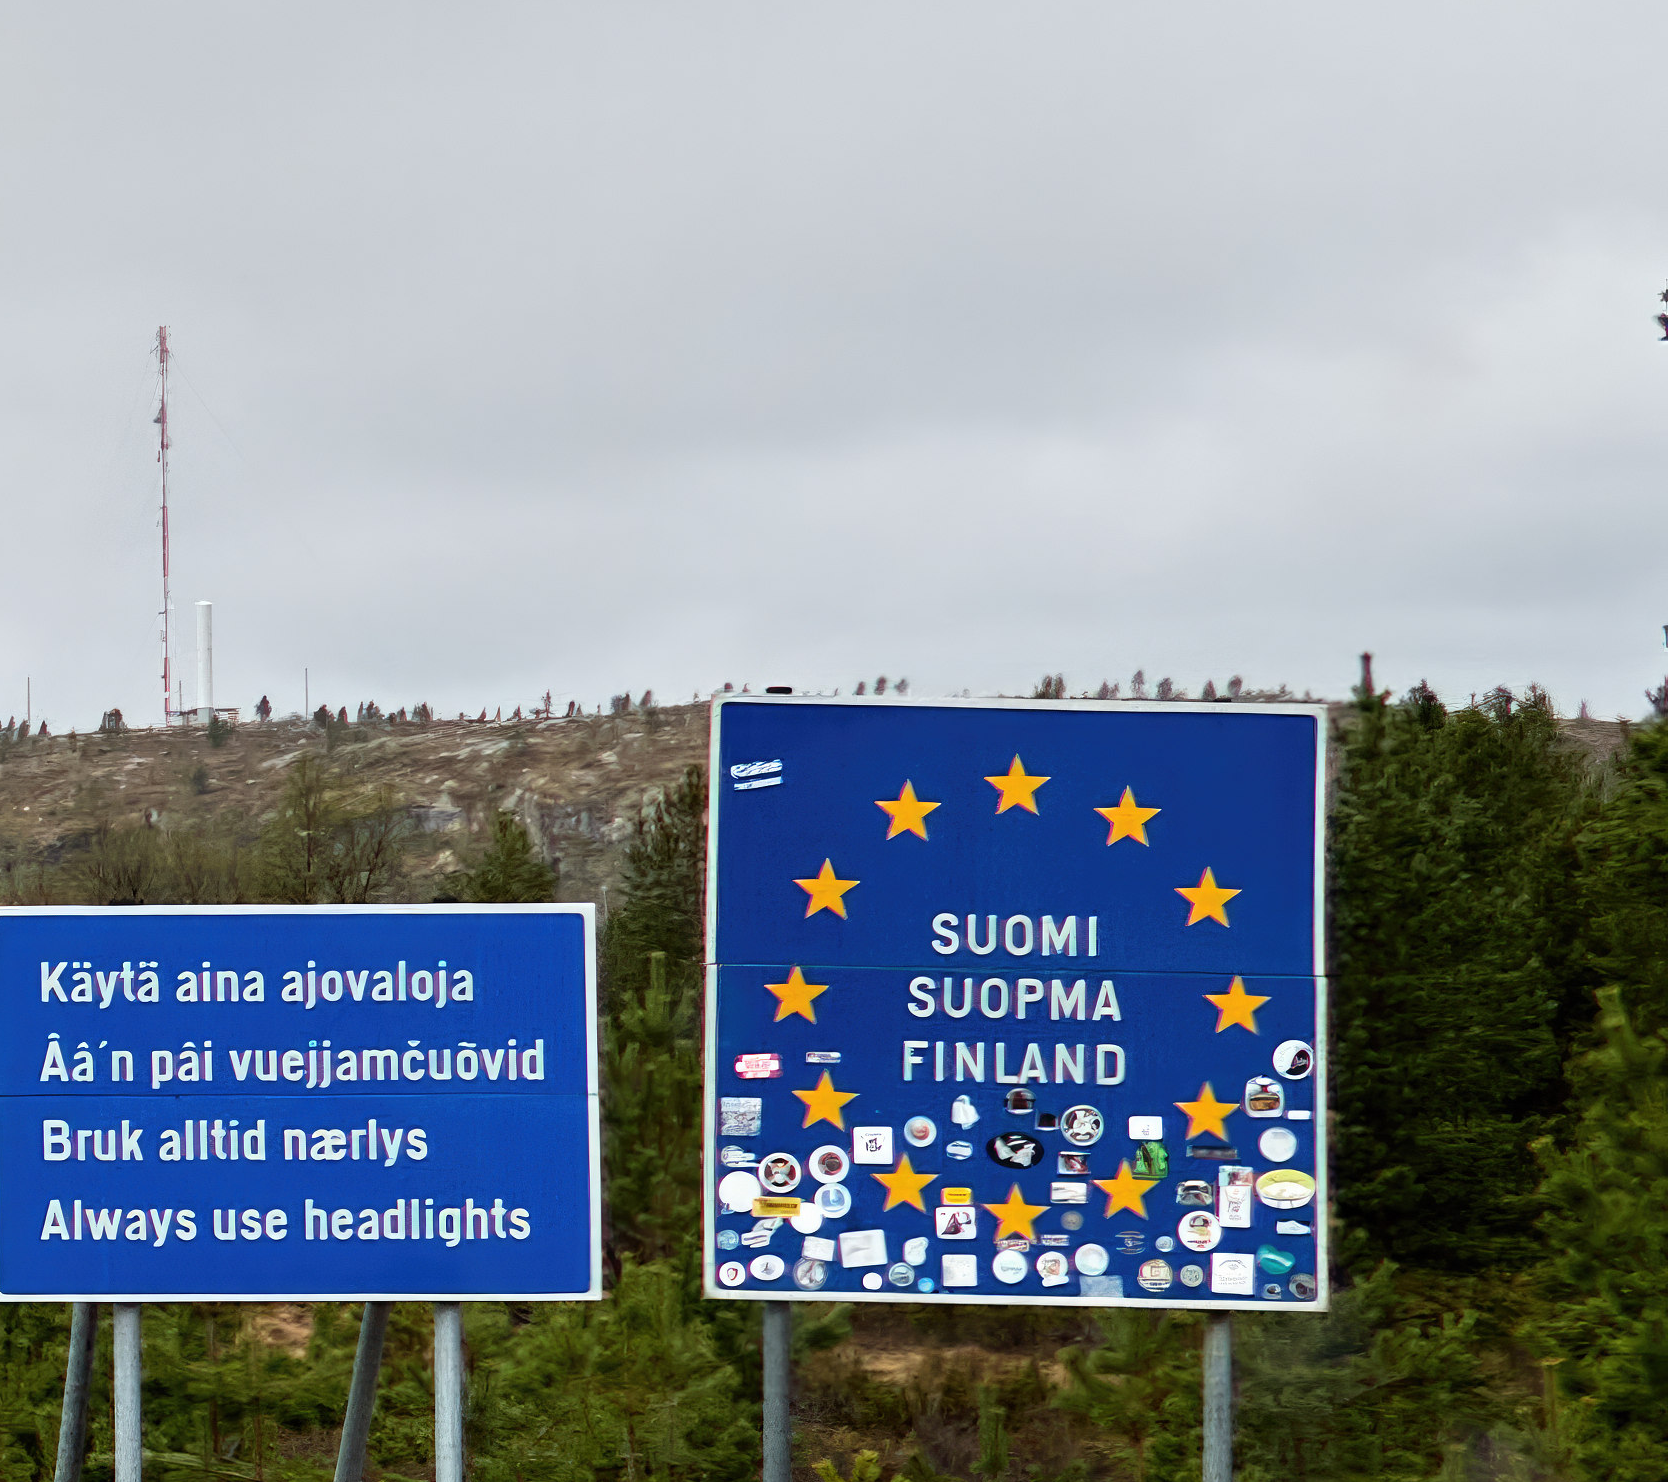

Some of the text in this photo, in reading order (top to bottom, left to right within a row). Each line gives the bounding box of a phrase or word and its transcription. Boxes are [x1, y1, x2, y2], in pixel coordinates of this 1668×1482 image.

[932, 913, 1097, 956] SUOMI
[41, 961, 474, 1009] Käytä aina ajovaloja
[908, 977, 1122, 1021] SUOPMA
[151, 1041, 213, 1089] pâi
[904, 1041, 1126, 1085] FINLAND
[43, 1119, 428, 1166] Bruk alltid nærlys
[41, 1198, 531, 1247] Always use headlights
